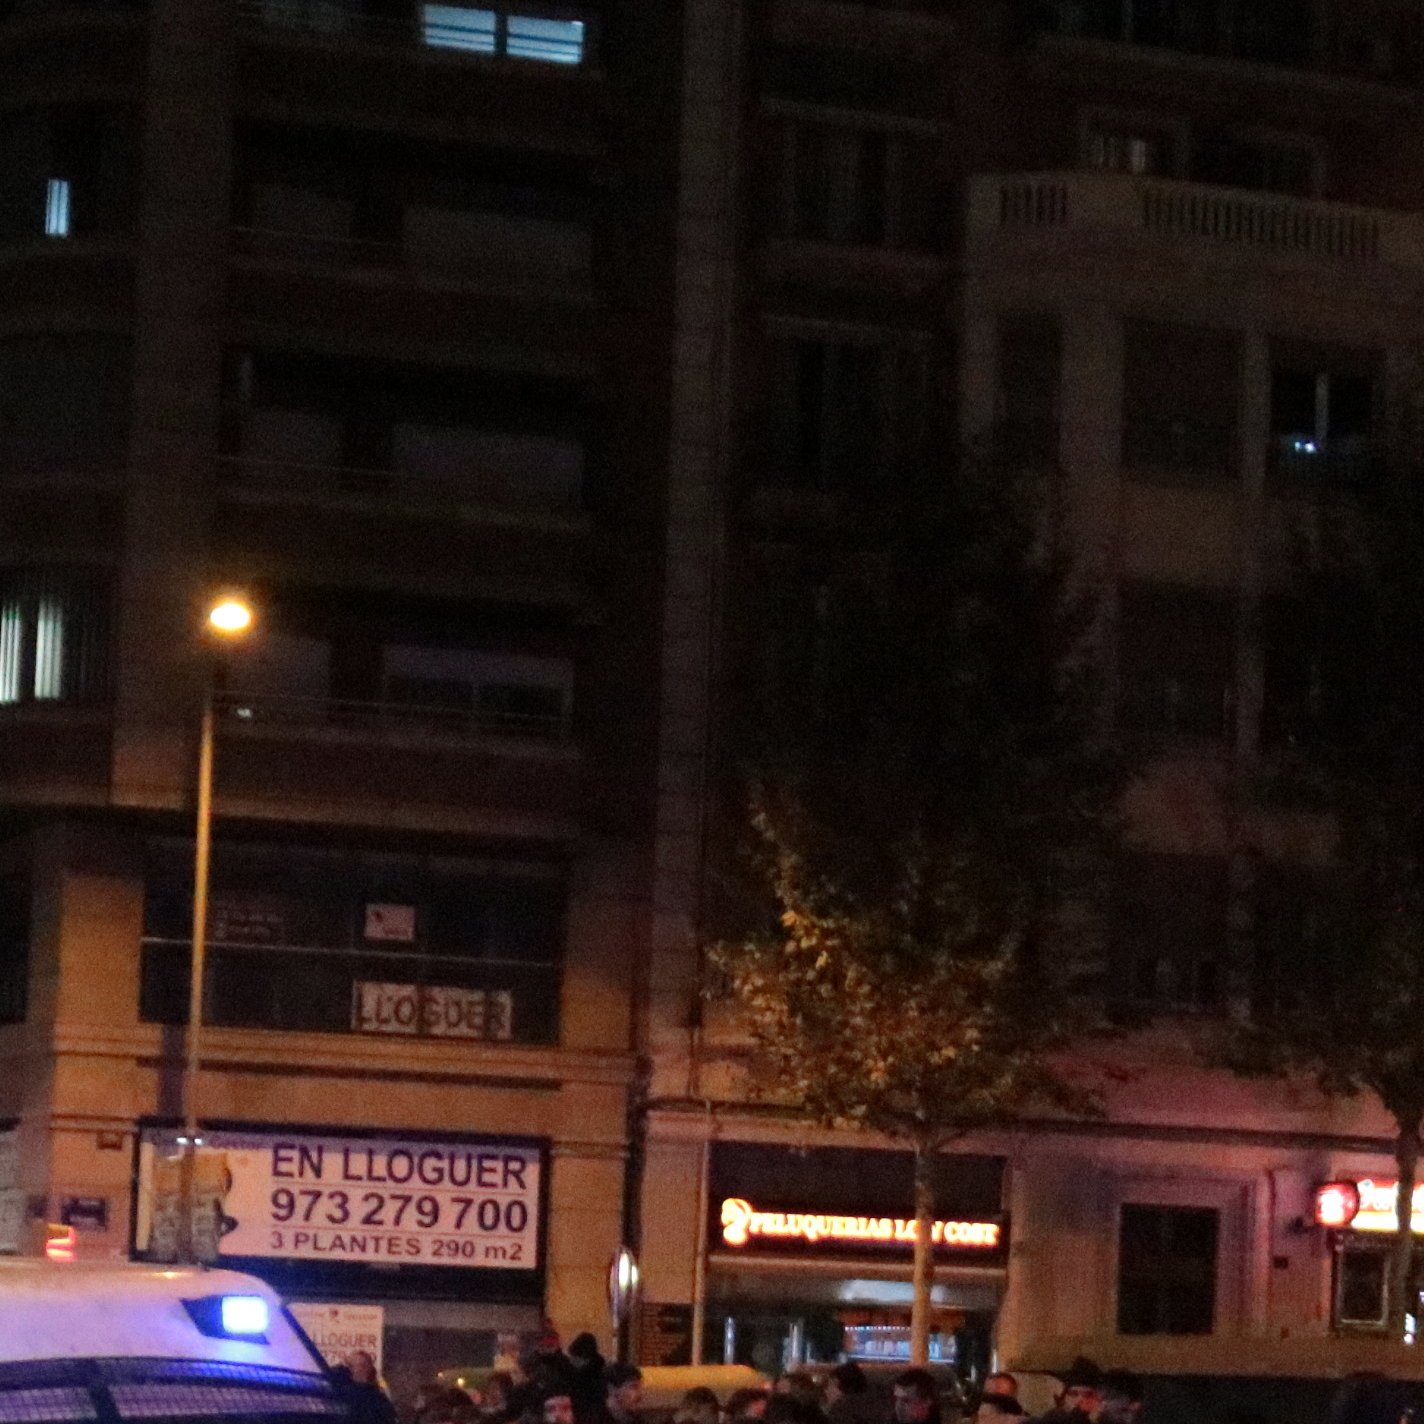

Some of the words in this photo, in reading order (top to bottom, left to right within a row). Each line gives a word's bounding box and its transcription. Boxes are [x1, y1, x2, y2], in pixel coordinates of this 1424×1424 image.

[357, 990, 507, 1032] LLOGUER
[271, 1142, 324, 1179] EN
[341, 1147, 528, 1191] LLOGUER
[271, 1188, 351, 1225] 973
[361, 1192, 440, 1229] 279
[450, 1197, 529, 1234] 700
[750, 1211, 892, 1243] PELUQUERIAS
[944, 1222, 999, 1246] COST
[270, 1231, 285, 1250] 3
[293, 1232, 422, 1258] PLANTES
[431, 1239, 475, 1259] 290
[484, 1242, 523, 1261] m2
